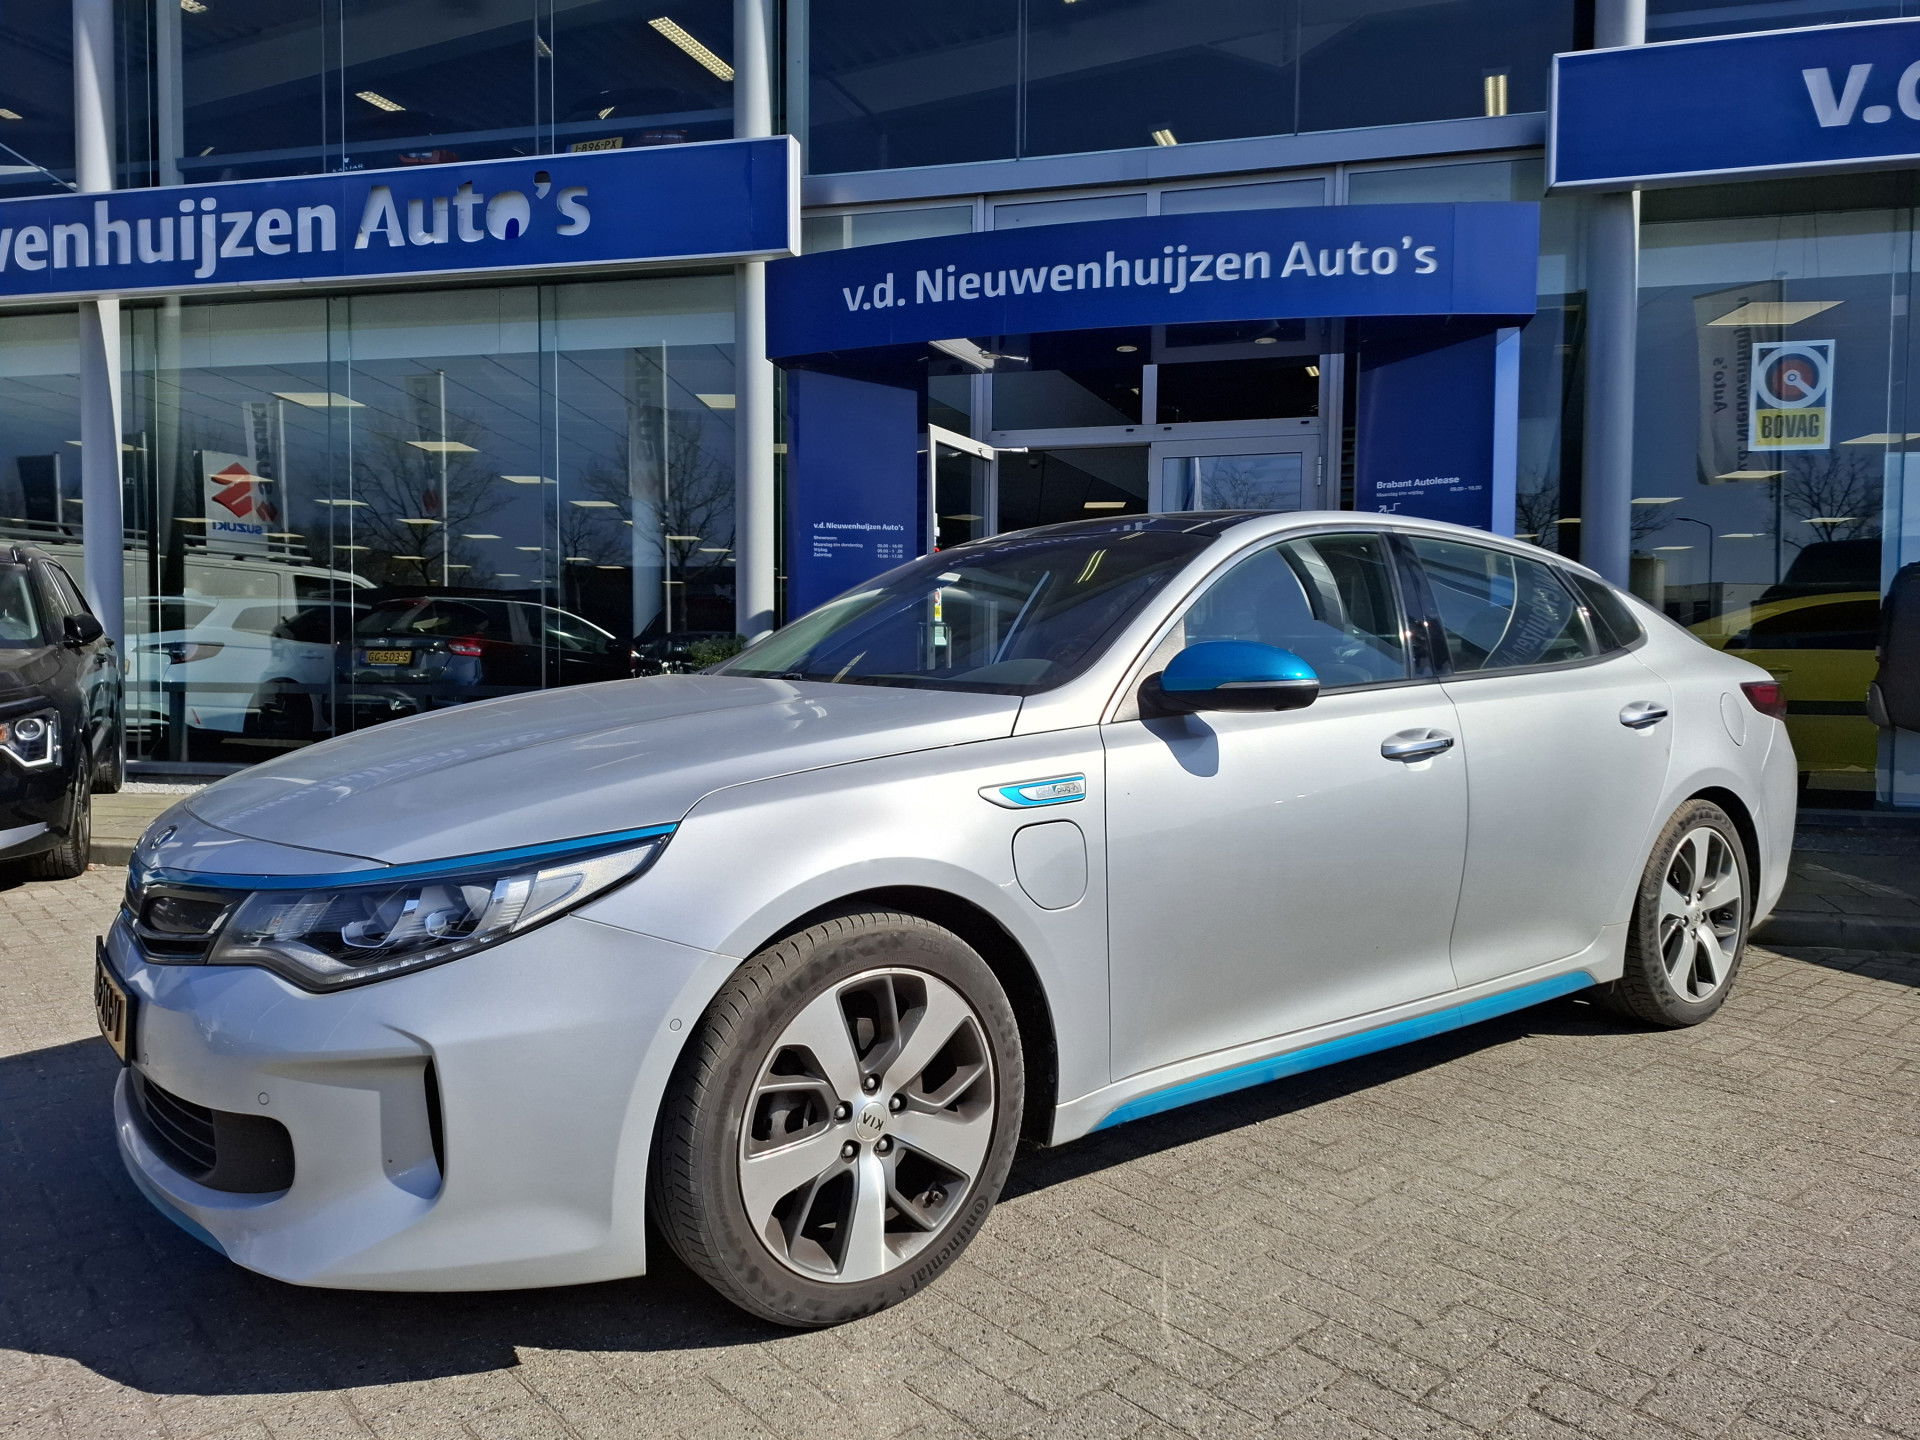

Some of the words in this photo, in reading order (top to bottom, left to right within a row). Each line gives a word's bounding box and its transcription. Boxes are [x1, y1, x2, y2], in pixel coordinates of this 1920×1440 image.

[0, 198, 337, 278] enhuijzen
[354, 171, 591, 250] Auto's
[843, 273, 906, 312] v.d.
[915, 245, 1271, 305] Nieuwenhuijzen
[1281, 235, 1440, 278] Auto's
[1761, 413, 1820, 439] BOVAG
[1376, 480, 1412, 489] Brabant
[1414, 477, 1460, 487] Autolease
[813, 521, 826, 529] v.d.
[826, 522, 881, 531] Nieuwenhuijzen
[863, 1112, 884, 1131] KIA
[911, 1195, 989, 1288] Continental
